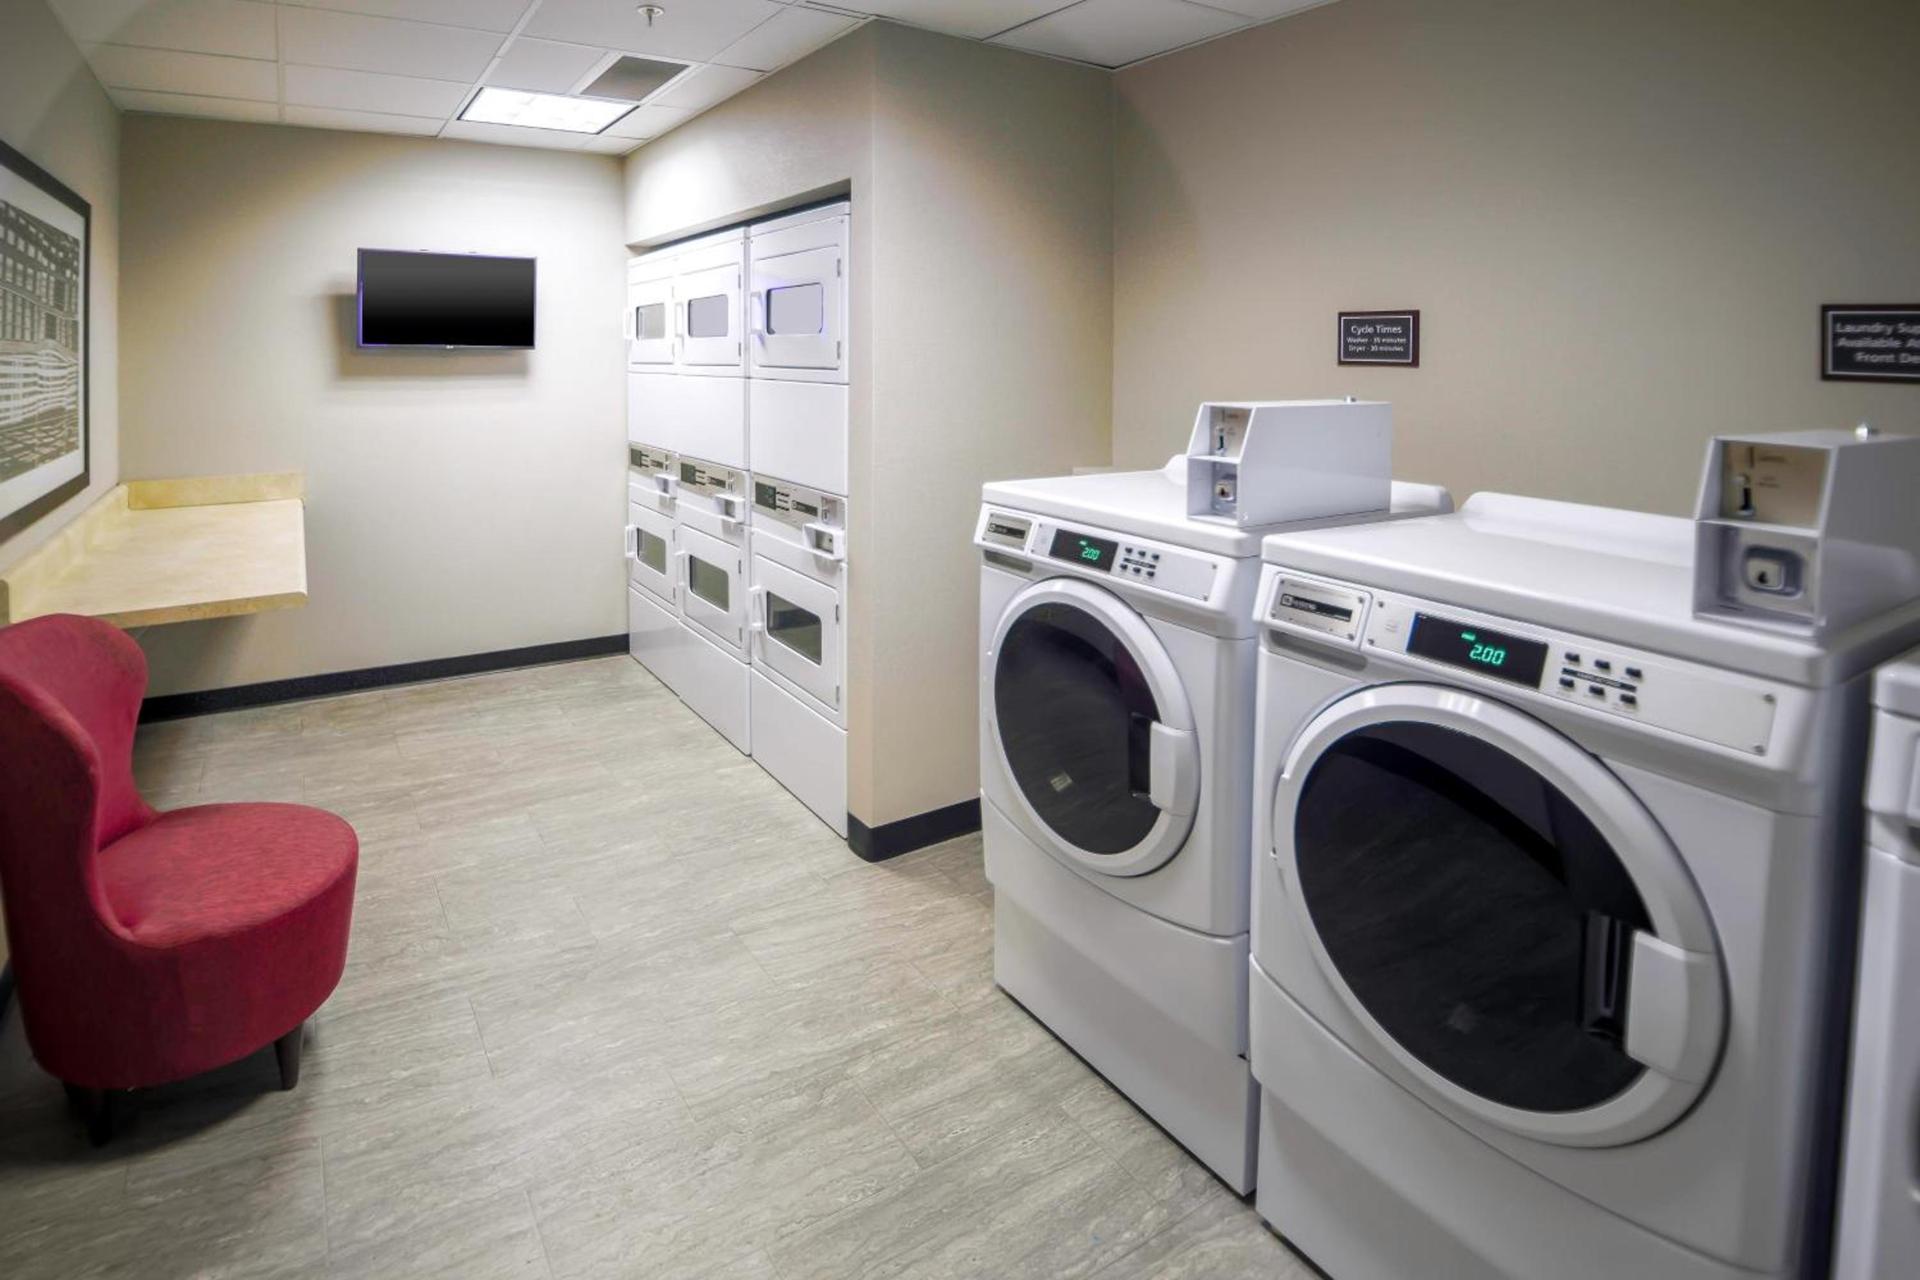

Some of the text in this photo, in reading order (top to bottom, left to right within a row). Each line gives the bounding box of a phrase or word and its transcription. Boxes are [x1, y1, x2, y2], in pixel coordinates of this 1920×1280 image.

[1351, 324, 1402, 335] Cycle Times
[1835, 322, 1893, 335] Laundry
[1837, 337, 1902, 348] Available
[1854, 352, 1896, 363] Front
[1469, 644, 1506, 665] 2.00
